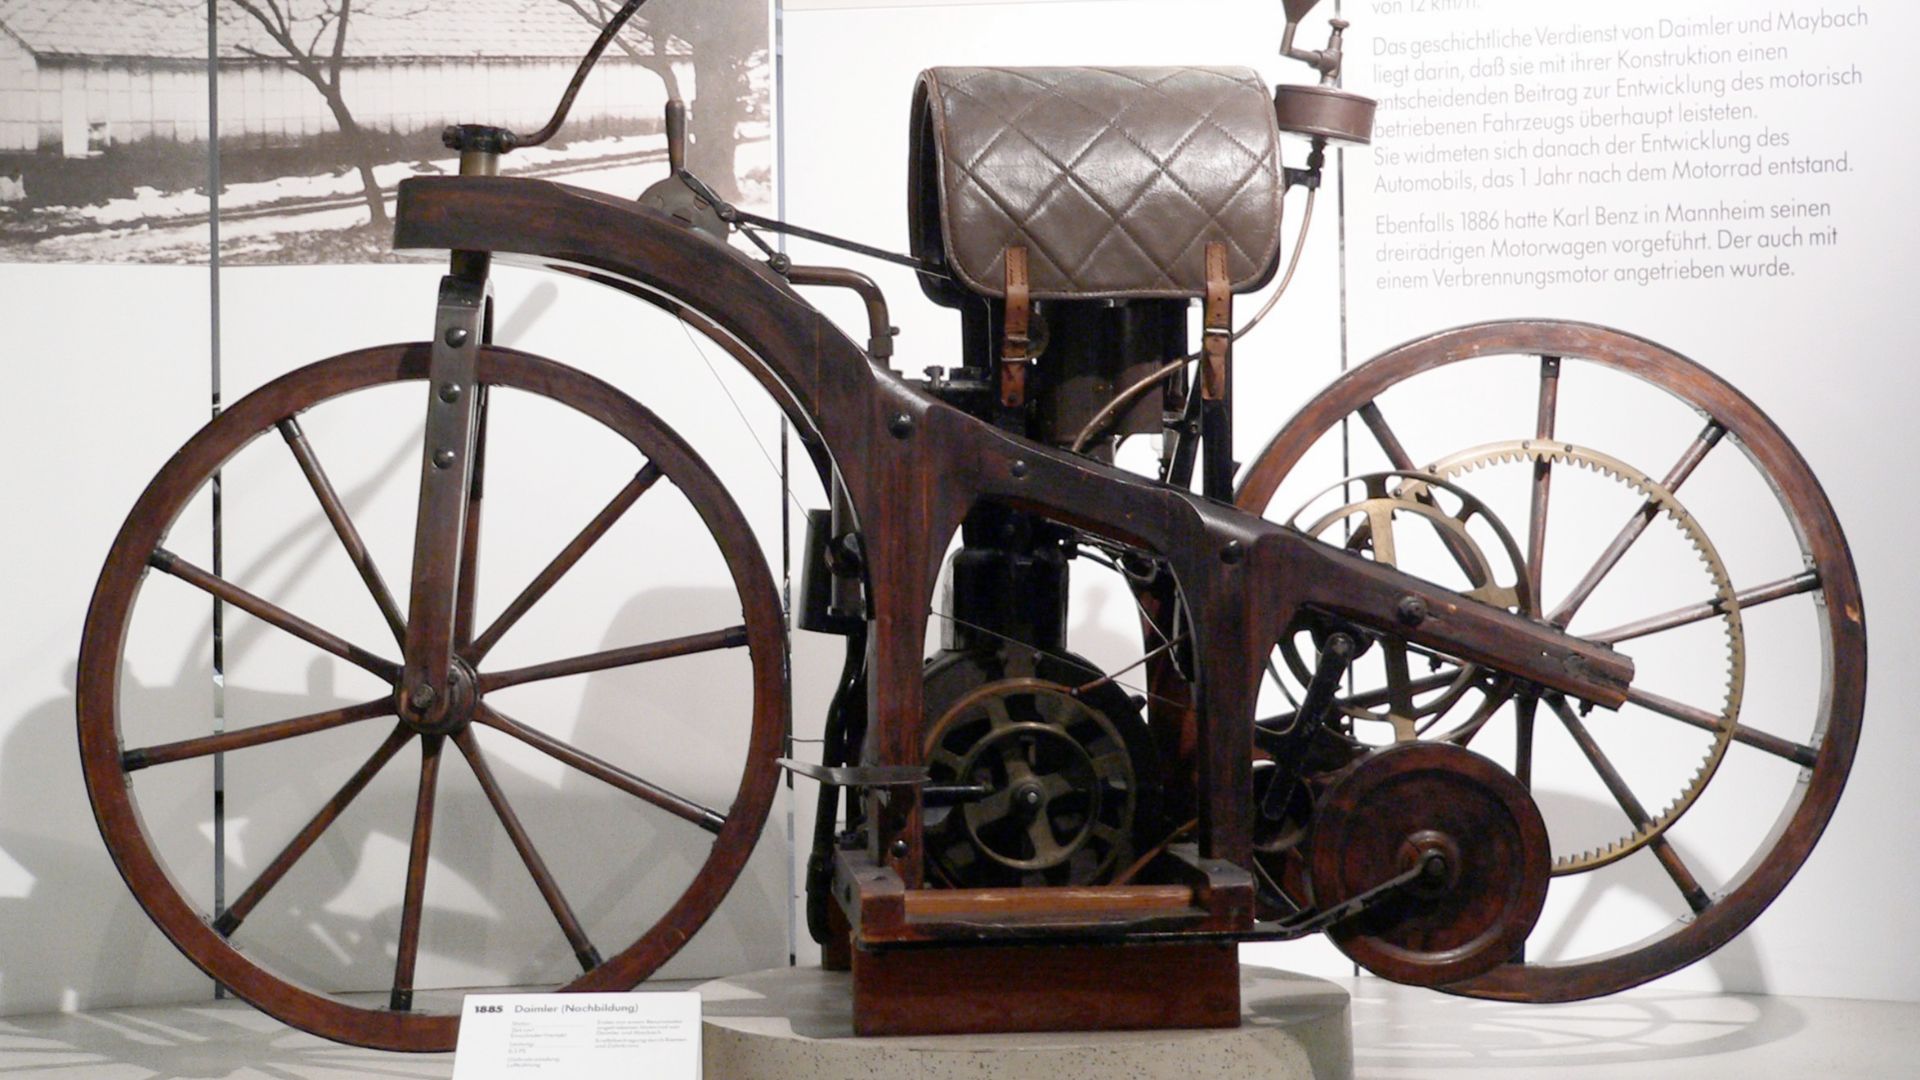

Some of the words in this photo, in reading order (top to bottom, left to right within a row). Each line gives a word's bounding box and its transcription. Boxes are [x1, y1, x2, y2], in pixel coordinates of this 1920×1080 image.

[1371, 0, 1402, 14] von
[1373, 37, 1407, 56] Das
[1410, 29, 1532, 59] geschichtliche
[1535, 23, 1618, 45] Verdienst
[1621, 26, 1654, 40] von
[1659, 15, 1733, 39] Daimler
[1738, 12, 1772, 34] und
[1777, 6, 1868, 34] Maybach
[1373, 64, 1409, 88] liegt
[1413, 57, 1465, 82] darin,
[1469, 56, 1505, 78] daß
[1510, 58, 1534, 75] sie
[1539, 54, 1565, 73] mit
[1571, 52, 1612, 72] ihrer
[1618, 45, 1731, 69] Konstruktion
[1737, 43, 1788, 62] einen
[1377, 88, 1508, 111] entscheidenden
[1514, 82, 1577, 106] Beitrag
[1584, 84, 1611, 99] zur
[1617, 73, 1725, 98] Entwicklung
[1731, 71, 1764, 91] des
[1770, 66, 1862, 88] motorisch
[1374, 116, 1477, 138] betriebenen
[1483, 110, 1574, 135] Fahrzeugs
[1580, 105, 1673, 128] überhaupt
[1679, 102, 1757, 122] leisteten.
[1374, 146, 1400, 166] Sie
[1404, 142, 1489, 164] widmeten
[1494, 139, 1527, 160] sich
[1533, 137, 1600, 158] danach
[1605, 134, 1636, 155] der
[1642, 129, 1751, 154] Entwicklung
[1757, 128, 1789, 147] des
[1374, 169, 1477, 193] Automobils,
[1482, 168, 1514, 188] das
[1520, 167, 1526, 186] 1
[1534, 165, 1573, 186] Jahr
[1578, 163, 1621, 184] nach
[1627, 162, 1666, 181] dem
[1672, 155, 1762, 179] Motorrad
[1768, 152, 1853, 175] entstand.
[1376, 212, 1454, 235] Ebenfalls
[1460, 211, 1499, 231] 1886
[1505, 210, 1547, 229] hatte
[1553, 207, 1589, 227] Karl
[1595, 206, 1638, 226] Benz
[1644, 205, 1659, 223] in
[1665, 201, 1765, 222] Mannheim
[1770, 199, 1830, 218] seinen
[1376, 240, 1486, 265] dreirädrigen
[1491, 238, 1607, 260] Motorwagen
[1612, 231, 1711, 257] vorgeführt.
[1718, 229, 1752, 249] Der
[1757, 227, 1803, 248] auch
[1809, 227, 1837, 245] mit
[1376, 271, 1428, 289] einem
[1432, 261, 1609, 290] Verbrennungsmotor
[1614, 259, 1724, 286] angetrieben
[1730, 256, 1794, 277] wurde.
[474, 1005, 503, 1013] 1885
[514, 1004, 558, 1013] Daimler
[561, 1003, 639, 1014] (Nachbildung)
